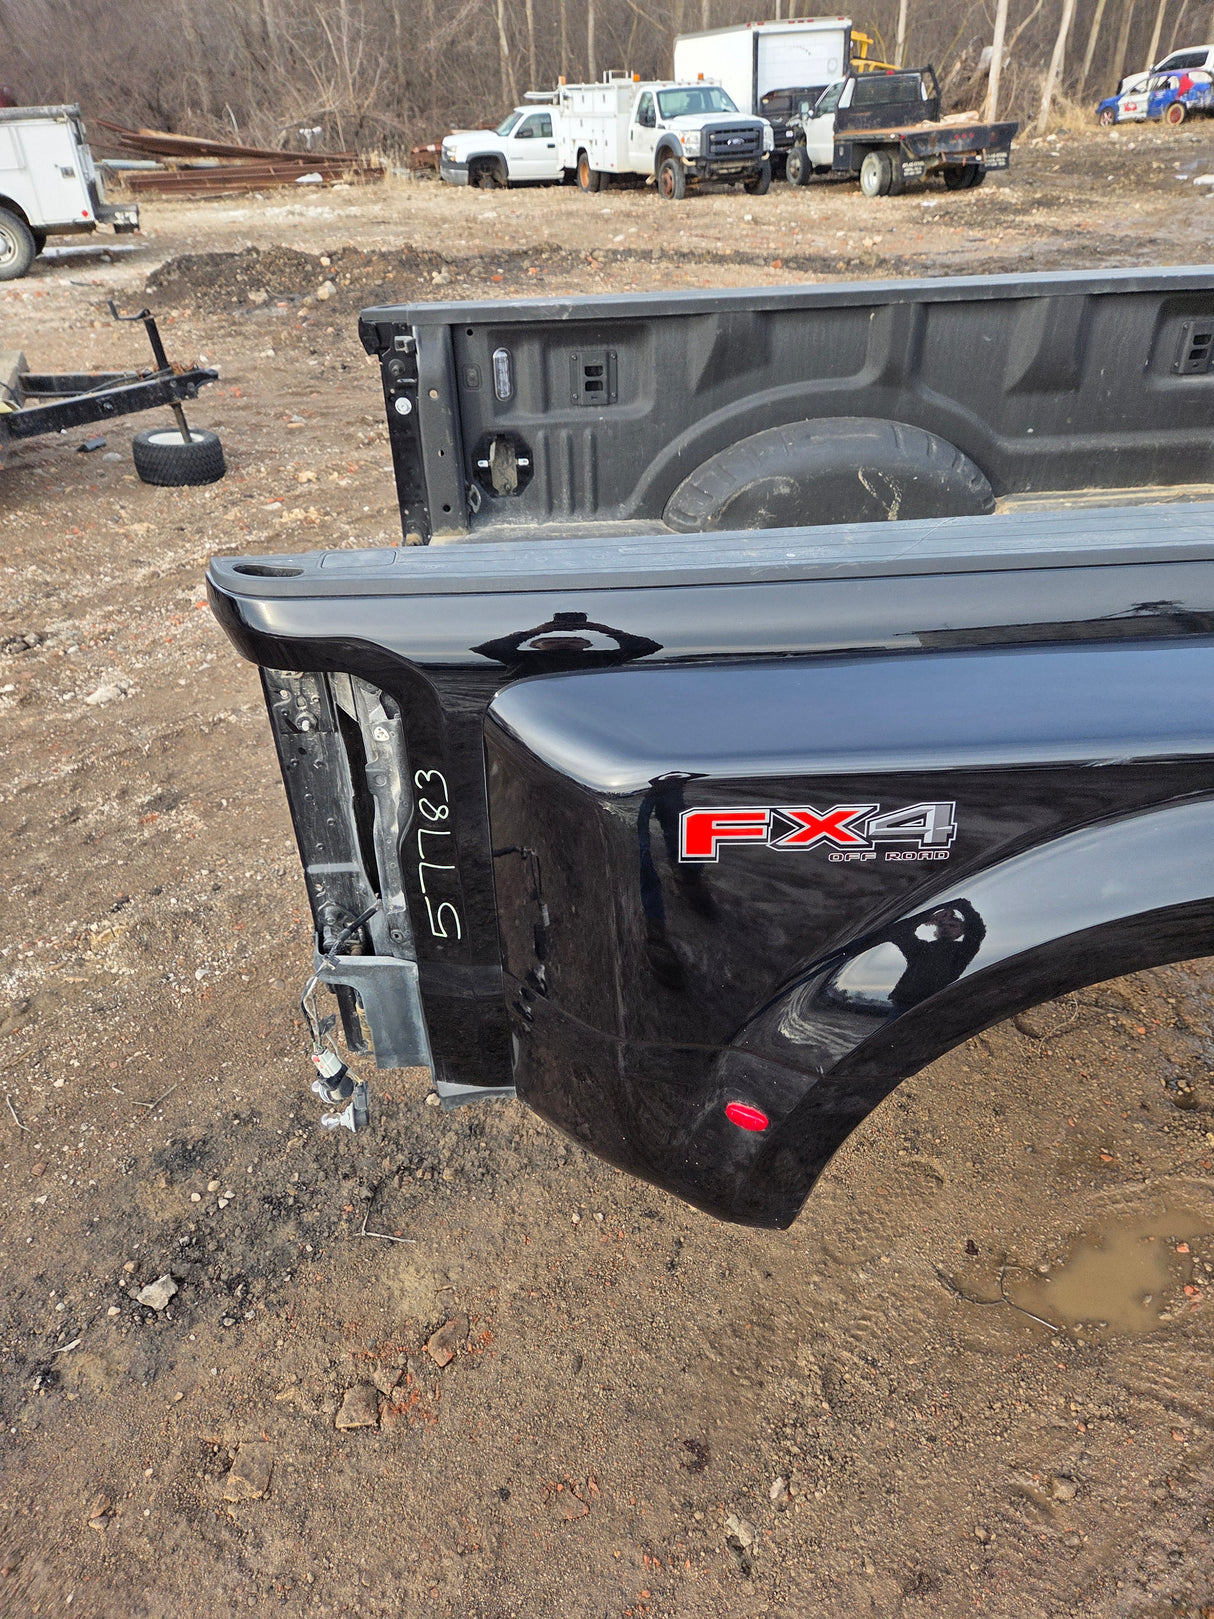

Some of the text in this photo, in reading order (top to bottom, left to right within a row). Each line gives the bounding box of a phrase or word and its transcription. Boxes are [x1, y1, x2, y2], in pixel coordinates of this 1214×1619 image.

[414, 769, 461, 940] 57783
[678, 801, 957, 862] FX4
[828, 850, 950, 862] OFF ROAD
